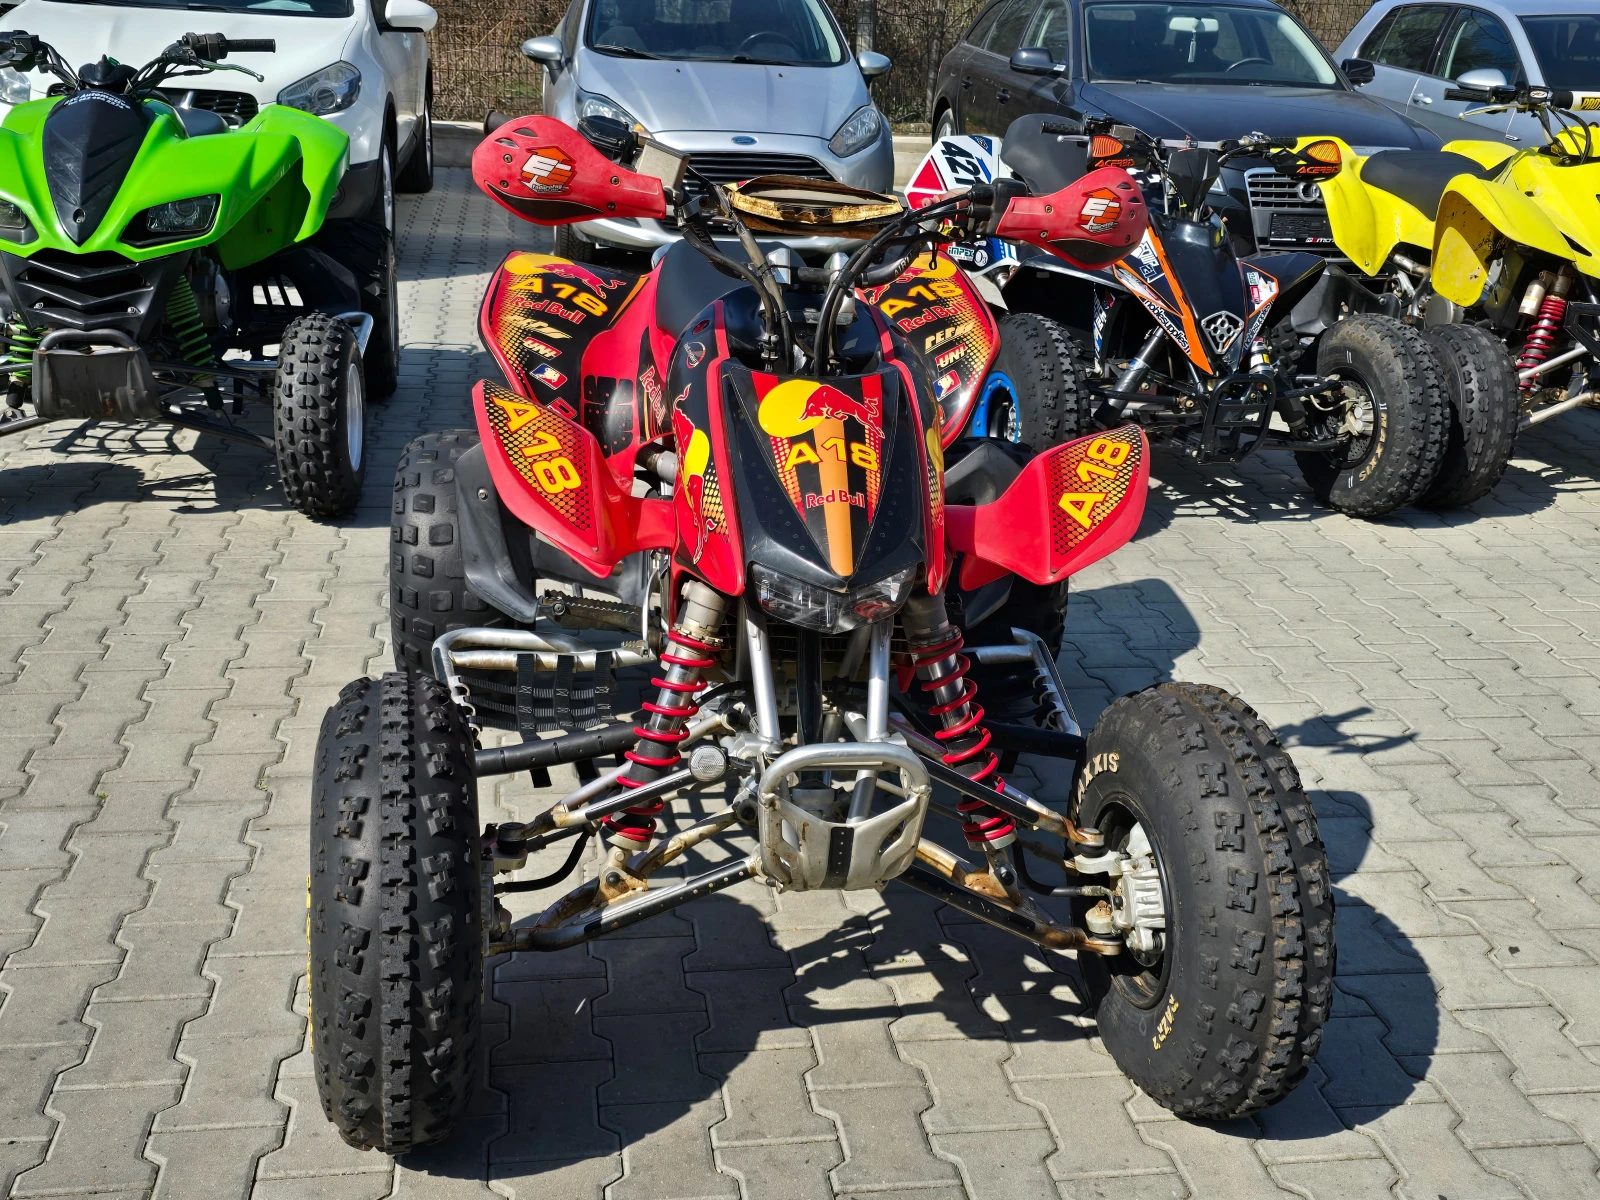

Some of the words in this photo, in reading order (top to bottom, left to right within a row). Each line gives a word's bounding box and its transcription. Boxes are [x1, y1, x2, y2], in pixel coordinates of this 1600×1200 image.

[508, 278, 608, 317] A18
[510, 295, 544, 311] Red
[545, 299, 587, 324] Bull
[879, 282, 964, 318] A18
[897, 309, 934, 333] Red
[933, 301, 968, 320] Bull
[937, 344, 968, 368] UNI
[490, 395, 582, 494] A18
[783, 436, 879, 472] A18
[806, 490, 836, 508] Red
[838, 489, 866, 508] Bull
[1058, 438, 1133, 531] A18
